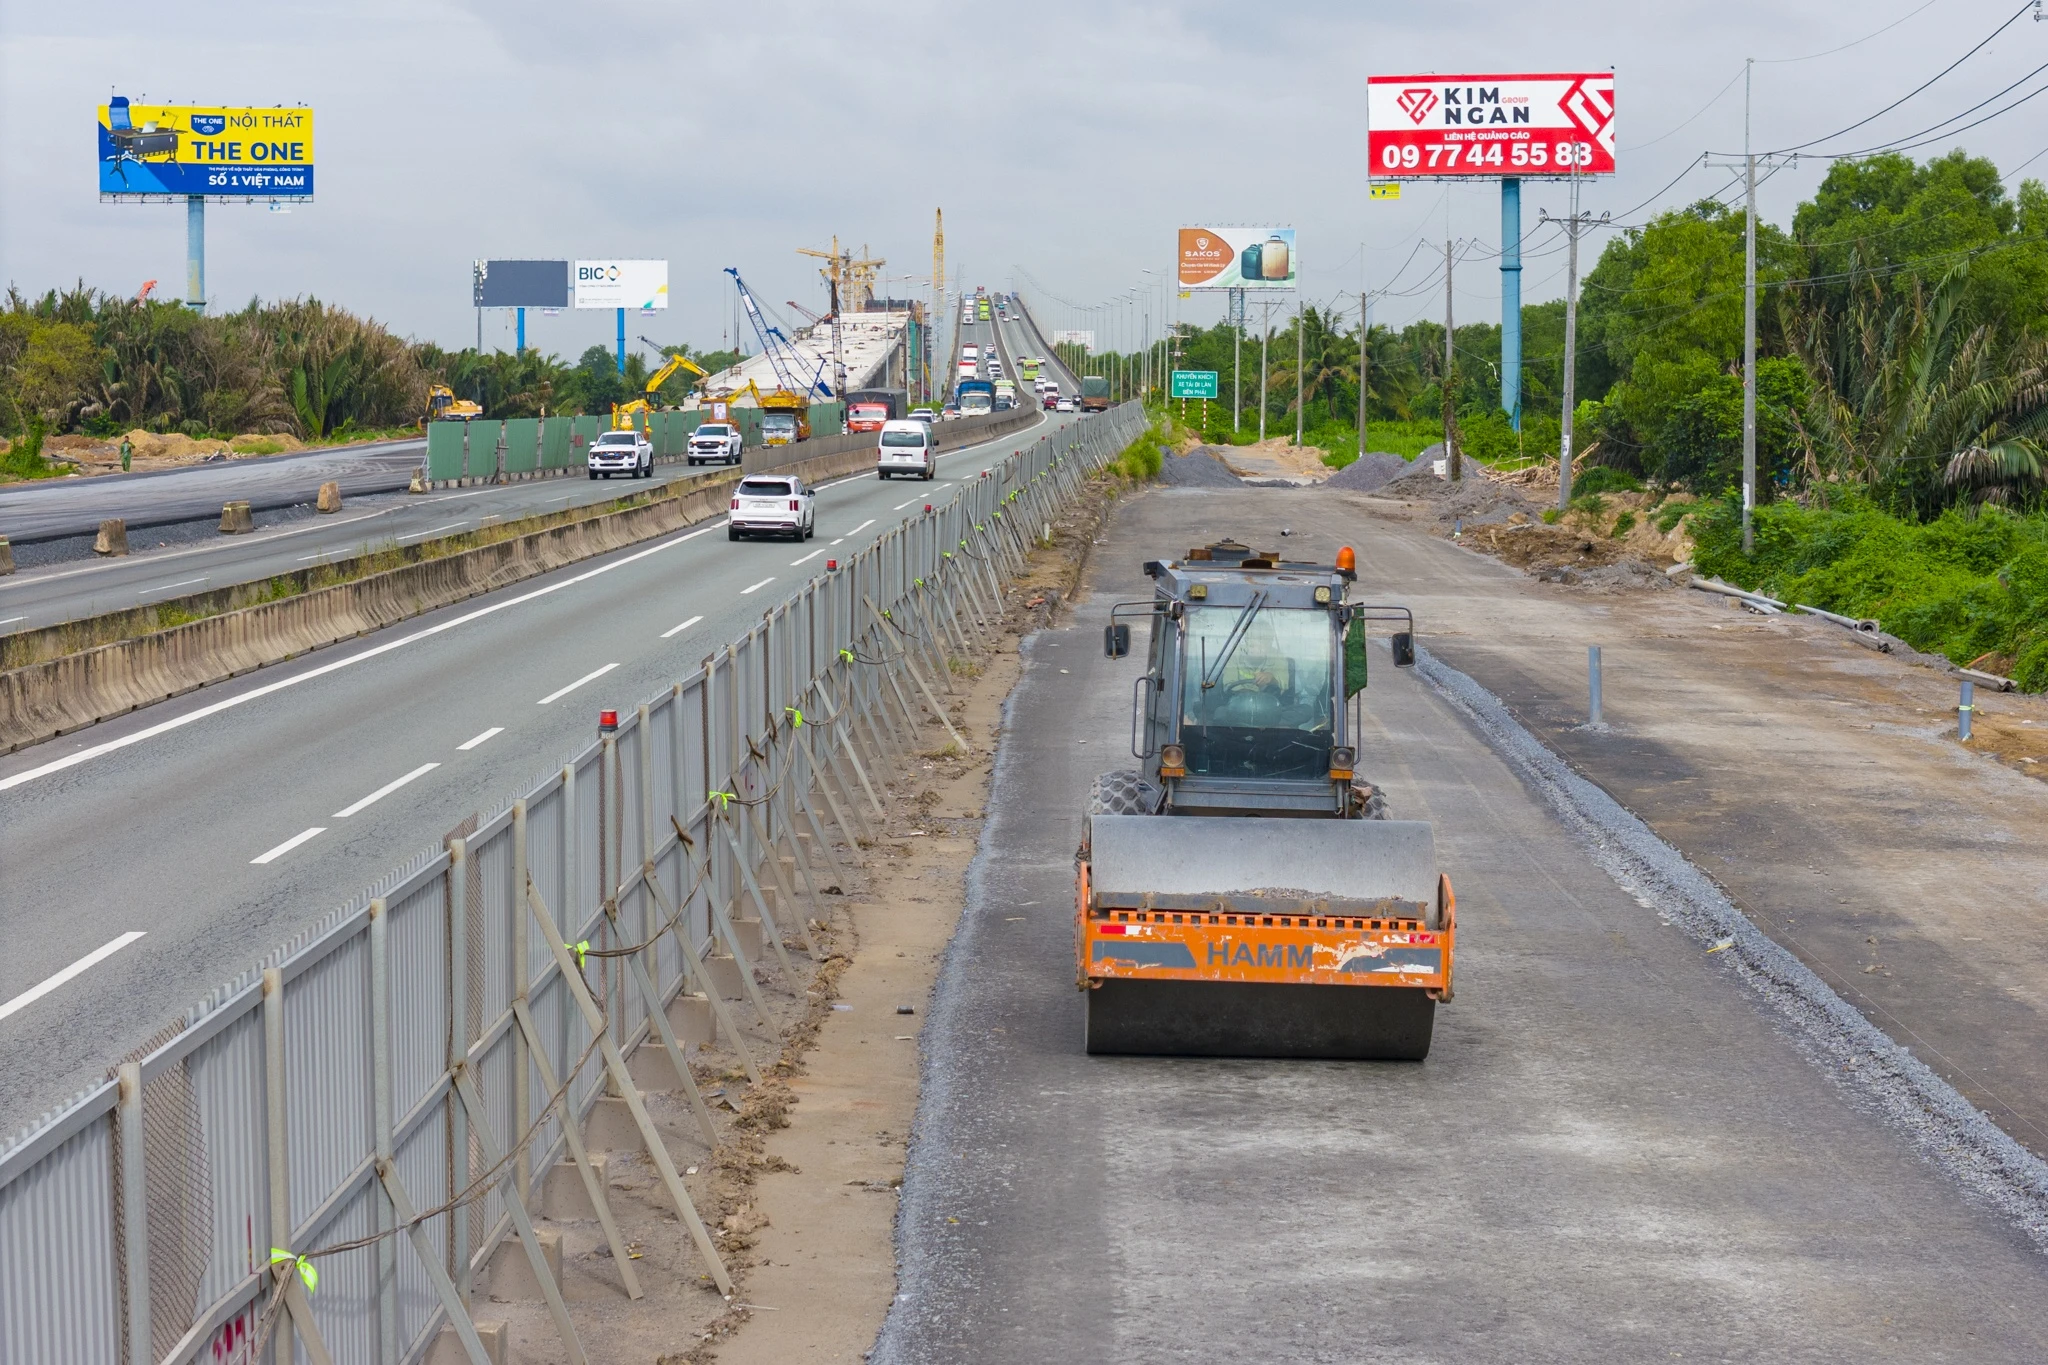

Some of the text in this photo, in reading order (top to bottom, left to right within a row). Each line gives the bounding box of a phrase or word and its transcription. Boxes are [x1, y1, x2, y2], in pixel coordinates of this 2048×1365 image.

[1444, 87, 1499, 105] KIM
[230, 111, 304, 131] NỘI THẤT
[1445, 106, 1529, 125] NGAN
[1444, 130, 1530, 142] LIÊN HỆ QUẢNG CÁO
[191, 141, 304, 161] THE ONE
[1382, 144, 1420, 169] 09
[1510, 142, 1548, 166] 55
[1555, 142, 1593, 166] 88
[208, 172, 304, 188] SỐ 1 VIỆT NAM
[1207, 941, 1313, 968] HAMM
